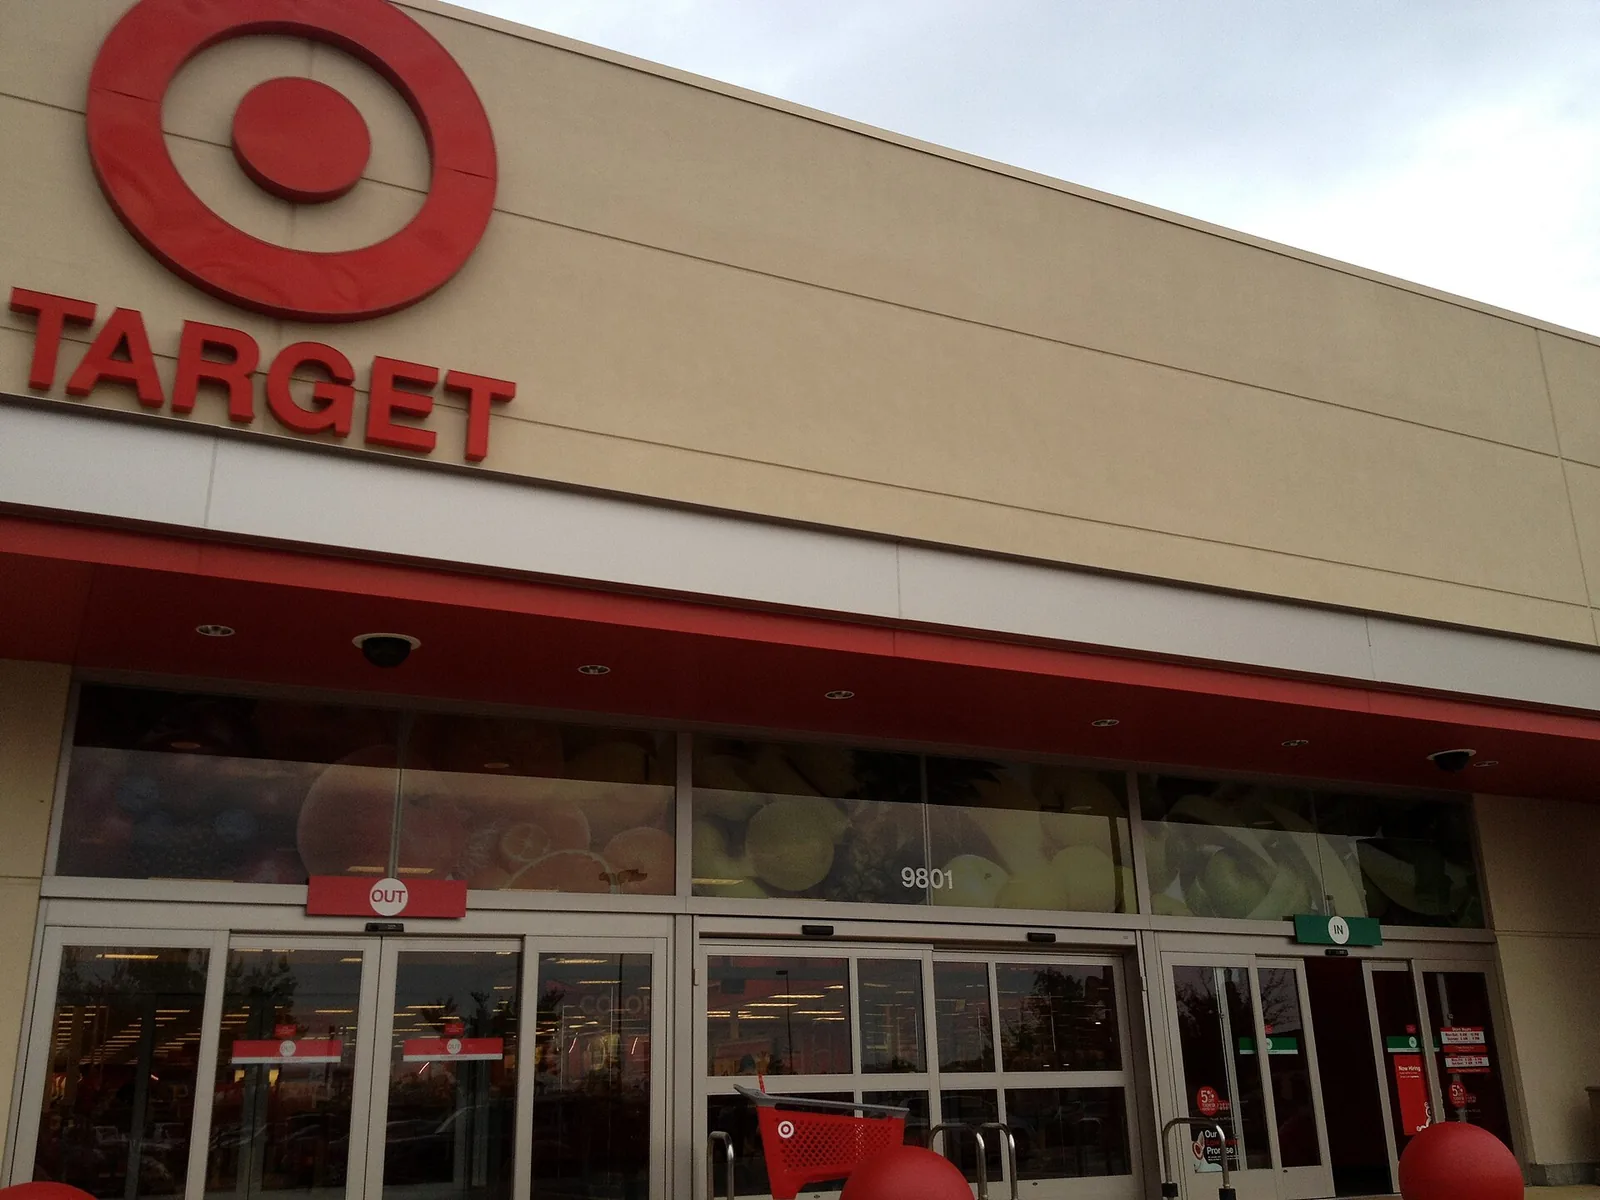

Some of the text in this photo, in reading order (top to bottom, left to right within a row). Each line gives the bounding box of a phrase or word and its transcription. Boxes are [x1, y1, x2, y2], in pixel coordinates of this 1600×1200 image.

[9, 286, 516, 462] TARGET
[901, 866, 953, 889] 9801
[371, 889, 406, 903] OUT
[1333, 924, 1344, 935] IN
[1204, 1129, 1217, 1138] Our
